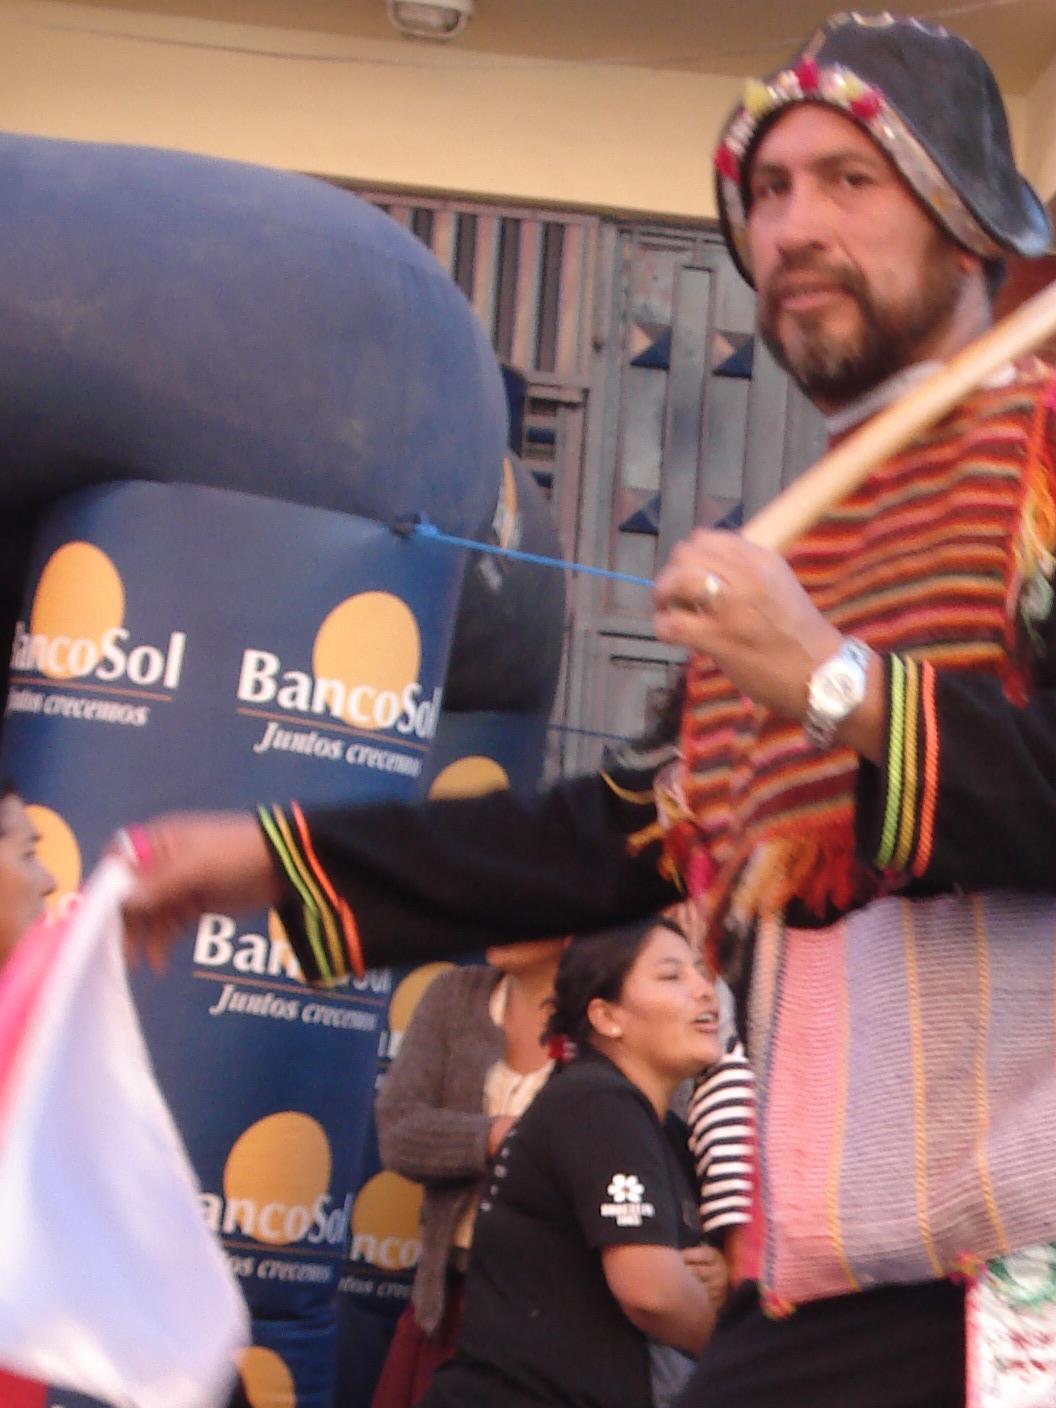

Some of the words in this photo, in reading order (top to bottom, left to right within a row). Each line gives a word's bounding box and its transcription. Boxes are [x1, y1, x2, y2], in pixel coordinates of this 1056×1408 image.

[236, 648, 443, 740] BancoSol
[253, 721, 345, 760] Juntos
[208, 983, 301, 1021] Juntos
